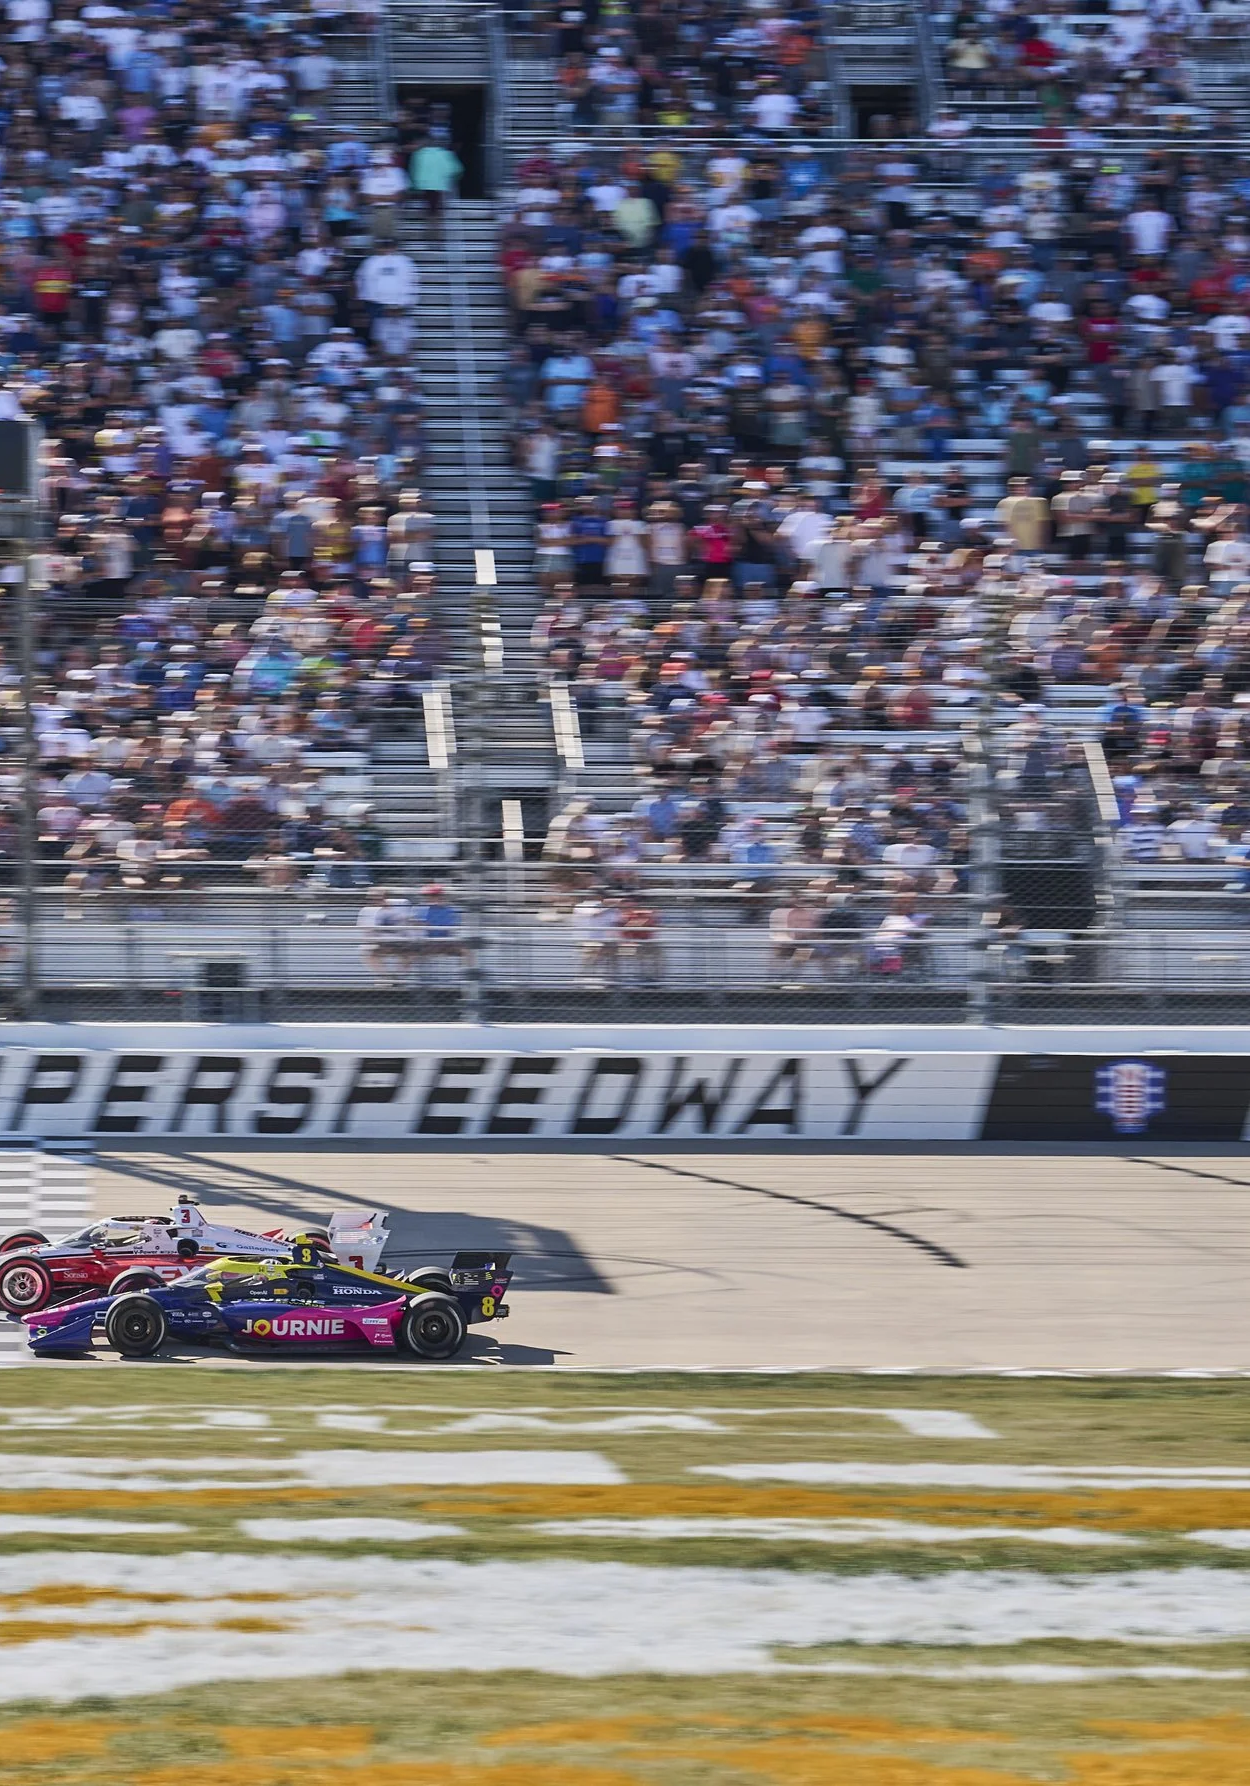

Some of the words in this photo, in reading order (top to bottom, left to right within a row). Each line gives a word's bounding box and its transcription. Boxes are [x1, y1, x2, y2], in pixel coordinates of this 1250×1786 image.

[180, 1209, 190, 1223] 3
[302, 1248, 311, 1262] 8
[482, 1296, 495, 1316] 8
[241, 1319, 345, 1336] JOURNIE
